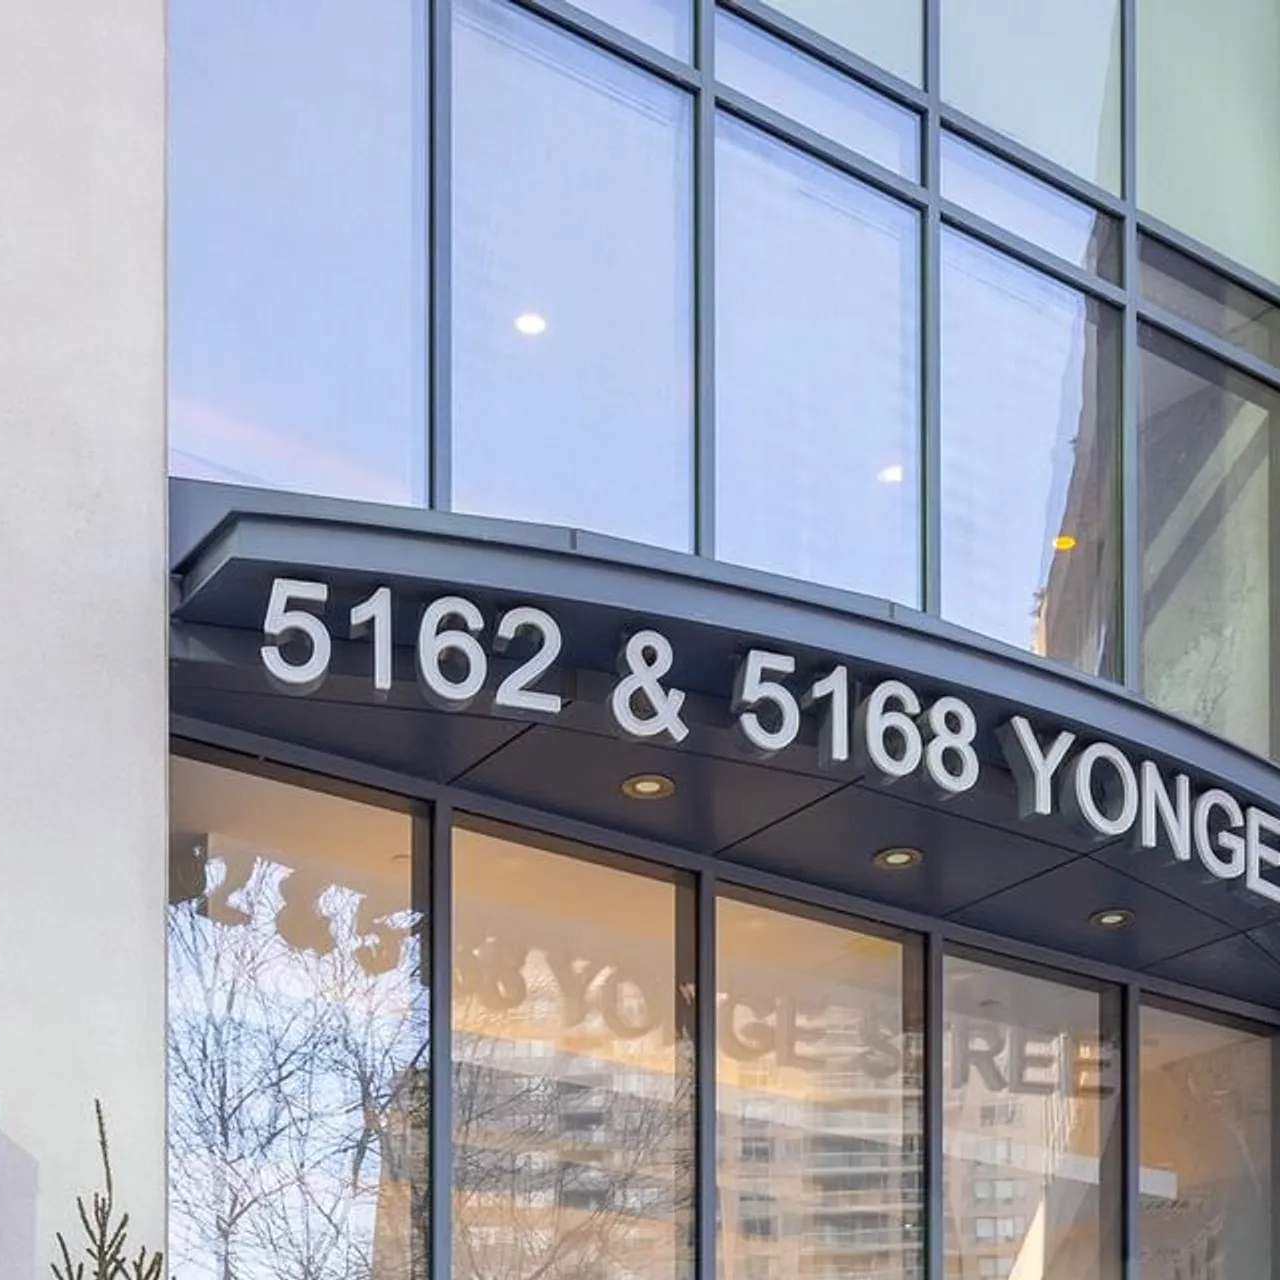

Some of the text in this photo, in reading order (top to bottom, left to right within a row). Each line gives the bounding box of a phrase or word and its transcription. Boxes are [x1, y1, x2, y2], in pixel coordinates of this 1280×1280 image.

[259, 577, 562, 714] 5162
[611, 629, 689, 744] &
[738, 648, 981, 793] 5168
